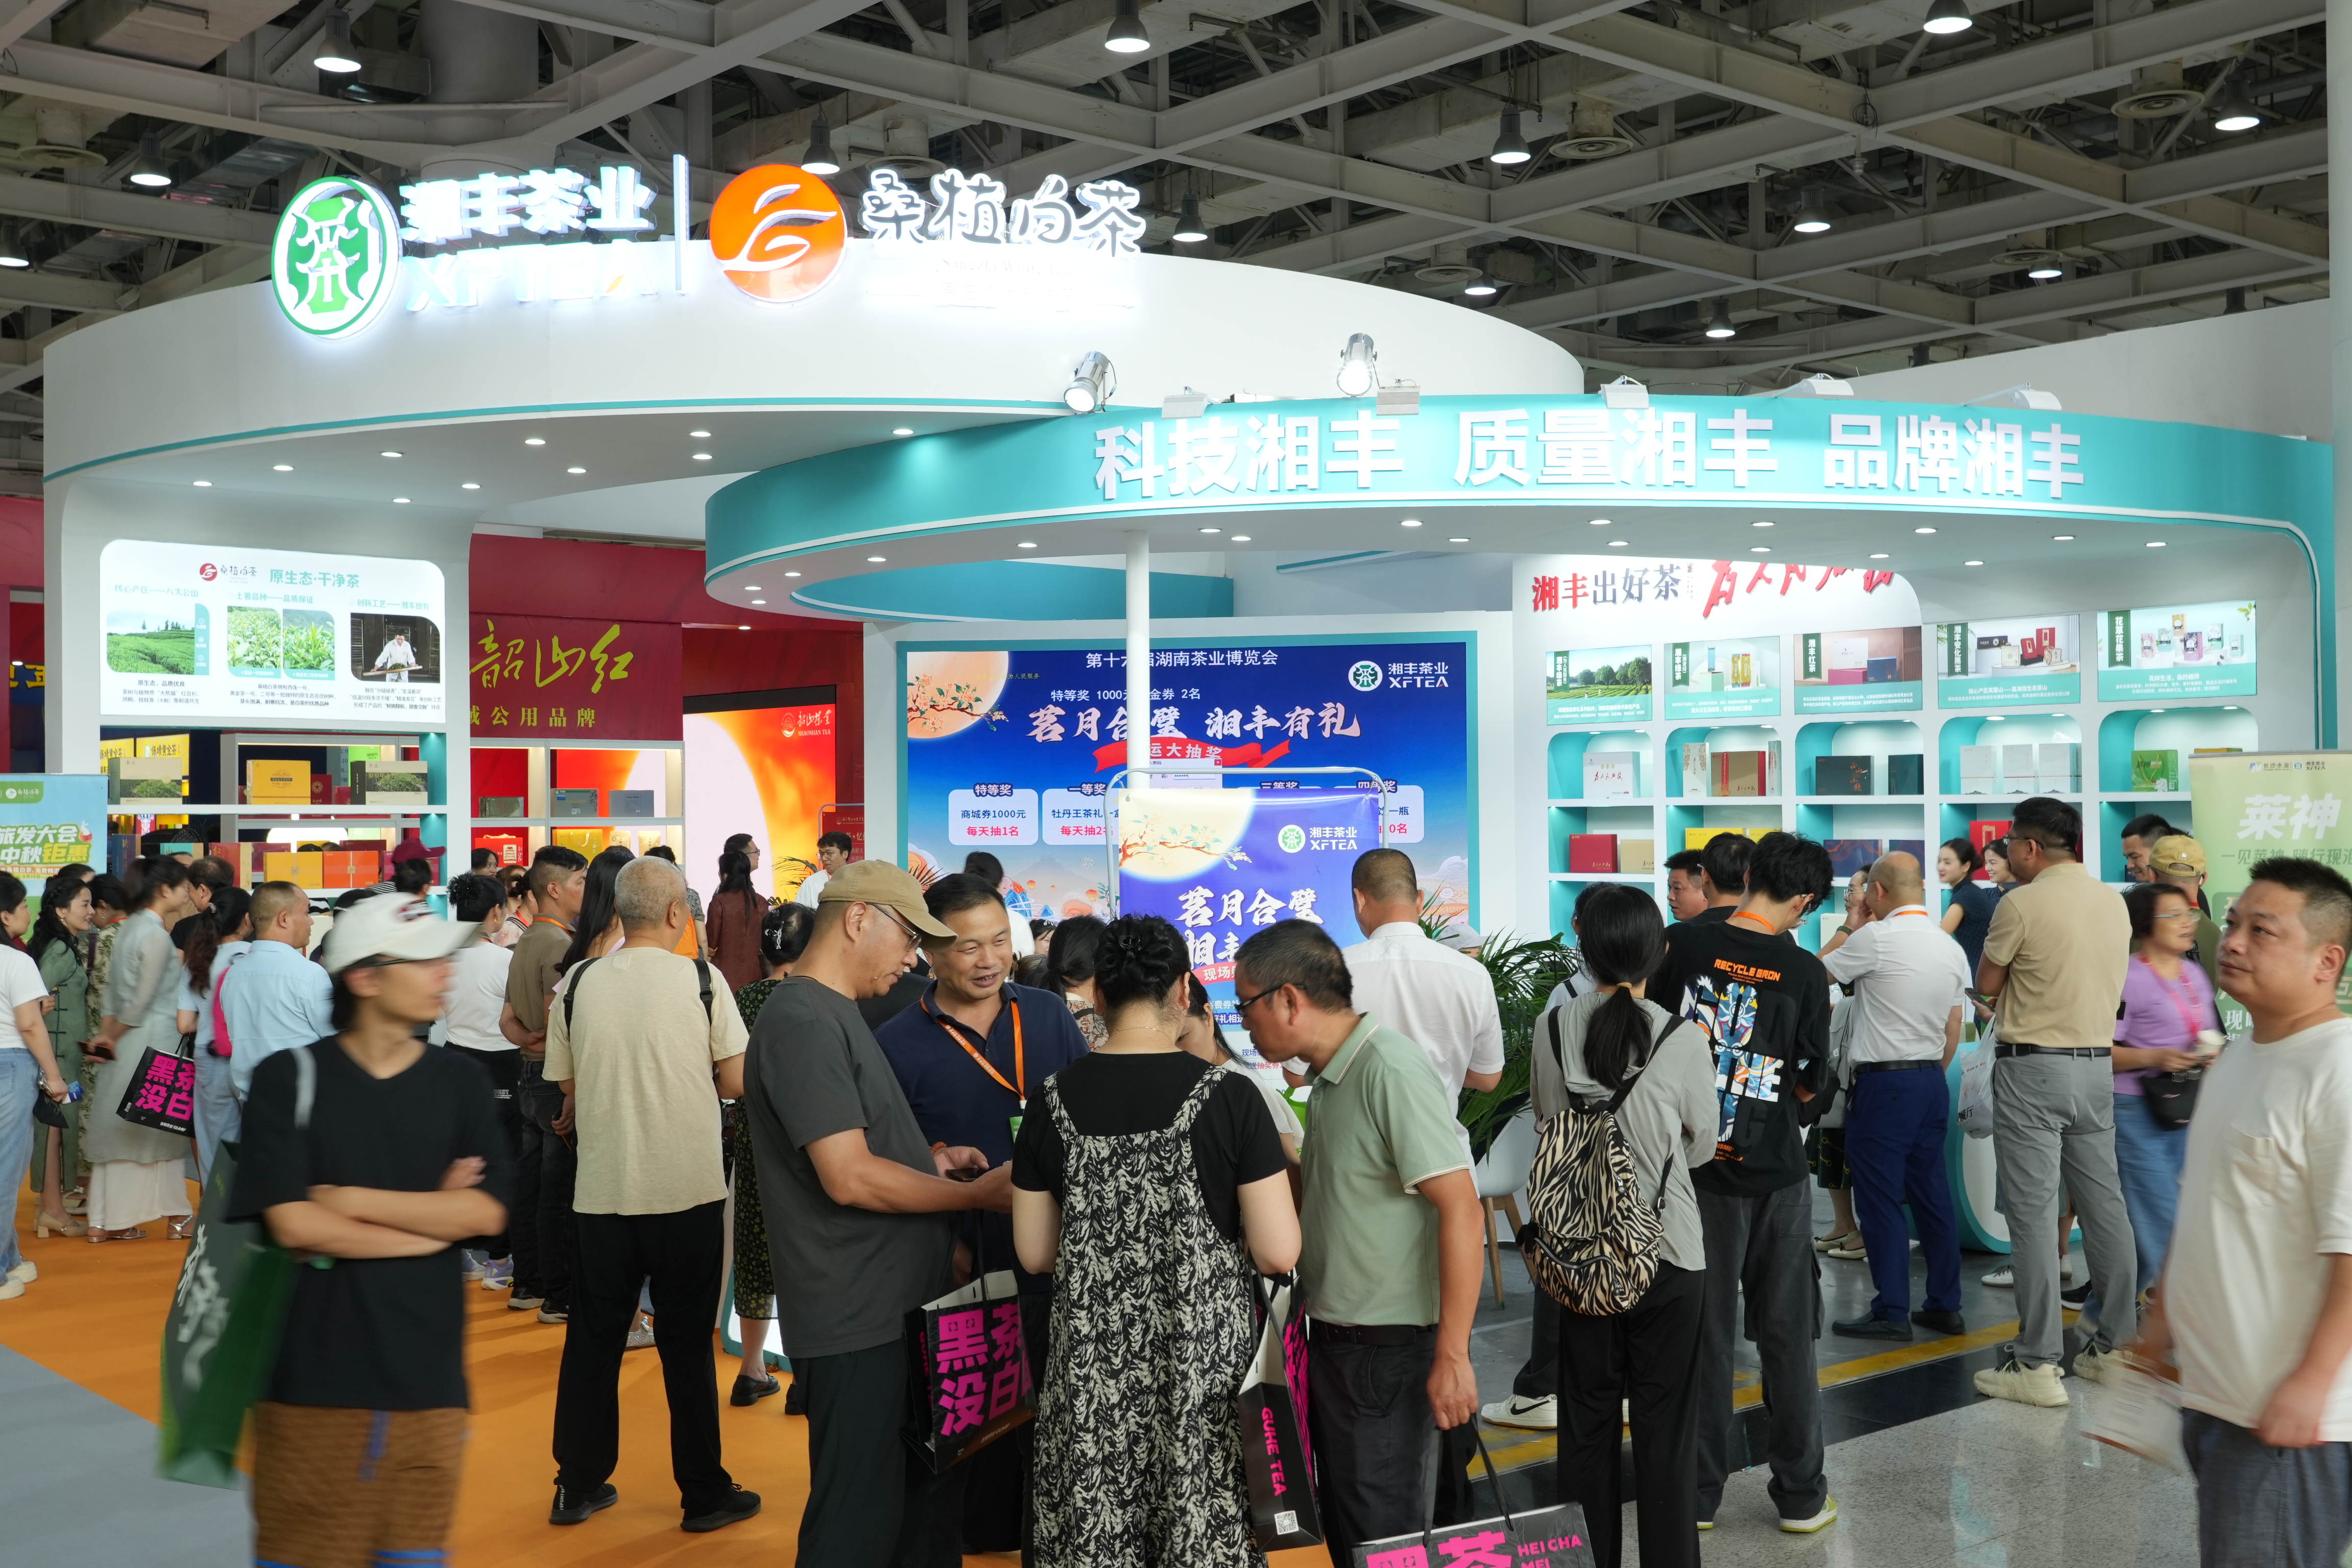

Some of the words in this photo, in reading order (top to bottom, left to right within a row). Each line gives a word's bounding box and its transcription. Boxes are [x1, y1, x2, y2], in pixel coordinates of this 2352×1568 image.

[400, 166, 657, 245] 湘丰茶业
[863, 168, 1147, 258] 桑植白茶
[1094, 410, 1404, 500] 科技湘丰
[1453, 408, 1778, 487] 质量湘丰
[1824, 414, 2085, 498] 品牌湘丰
[220, 565, 257, 577] 桑植白茶
[270, 569, 359, 588] 原生态·干净茶
[1531, 562, 1682, 612] 湘丰出好茶
[2115, 616, 2124, 662] 花草花果茶
[470, 619, 634, 694] 韶山红
[1086, 649, 1279, 668] 第十湖南茶业博览会
[1388, 662, 1449, 675] 湘丰茶业
[1389, 676, 1449, 689] XFTEA
[1050, 690, 1090, 701] 特等奖
[1182, 688, 1200, 699] 2名
[1205, 702, 1361, 740] 湘丰有礼
[975, 784, 1013, 797] 特等奖
[961, 808, 1026, 819] 商城券1000元
[2237, 793, 2342, 840] 莱神
[967, 826, 1019, 837] 每天抽1名
[1310, 826, 1358, 838] 湘丰茶业
[1, 843, 89, 864] 中秋钜惠
[1310, 839, 1358, 850] XFTEA
[1174, 886, 1324, 928] 茗月合璧
[1714, 959, 1756, 976] RECYCLE
[939, 1360, 1020, 1436] 没白
[1262, 1407, 1280, 1456] GUHE
[1270, 1459, 1287, 1497] TEA
[1517, 1541, 1546, 1557] HEI
[1548, 1534, 1582, 1552] CHA
